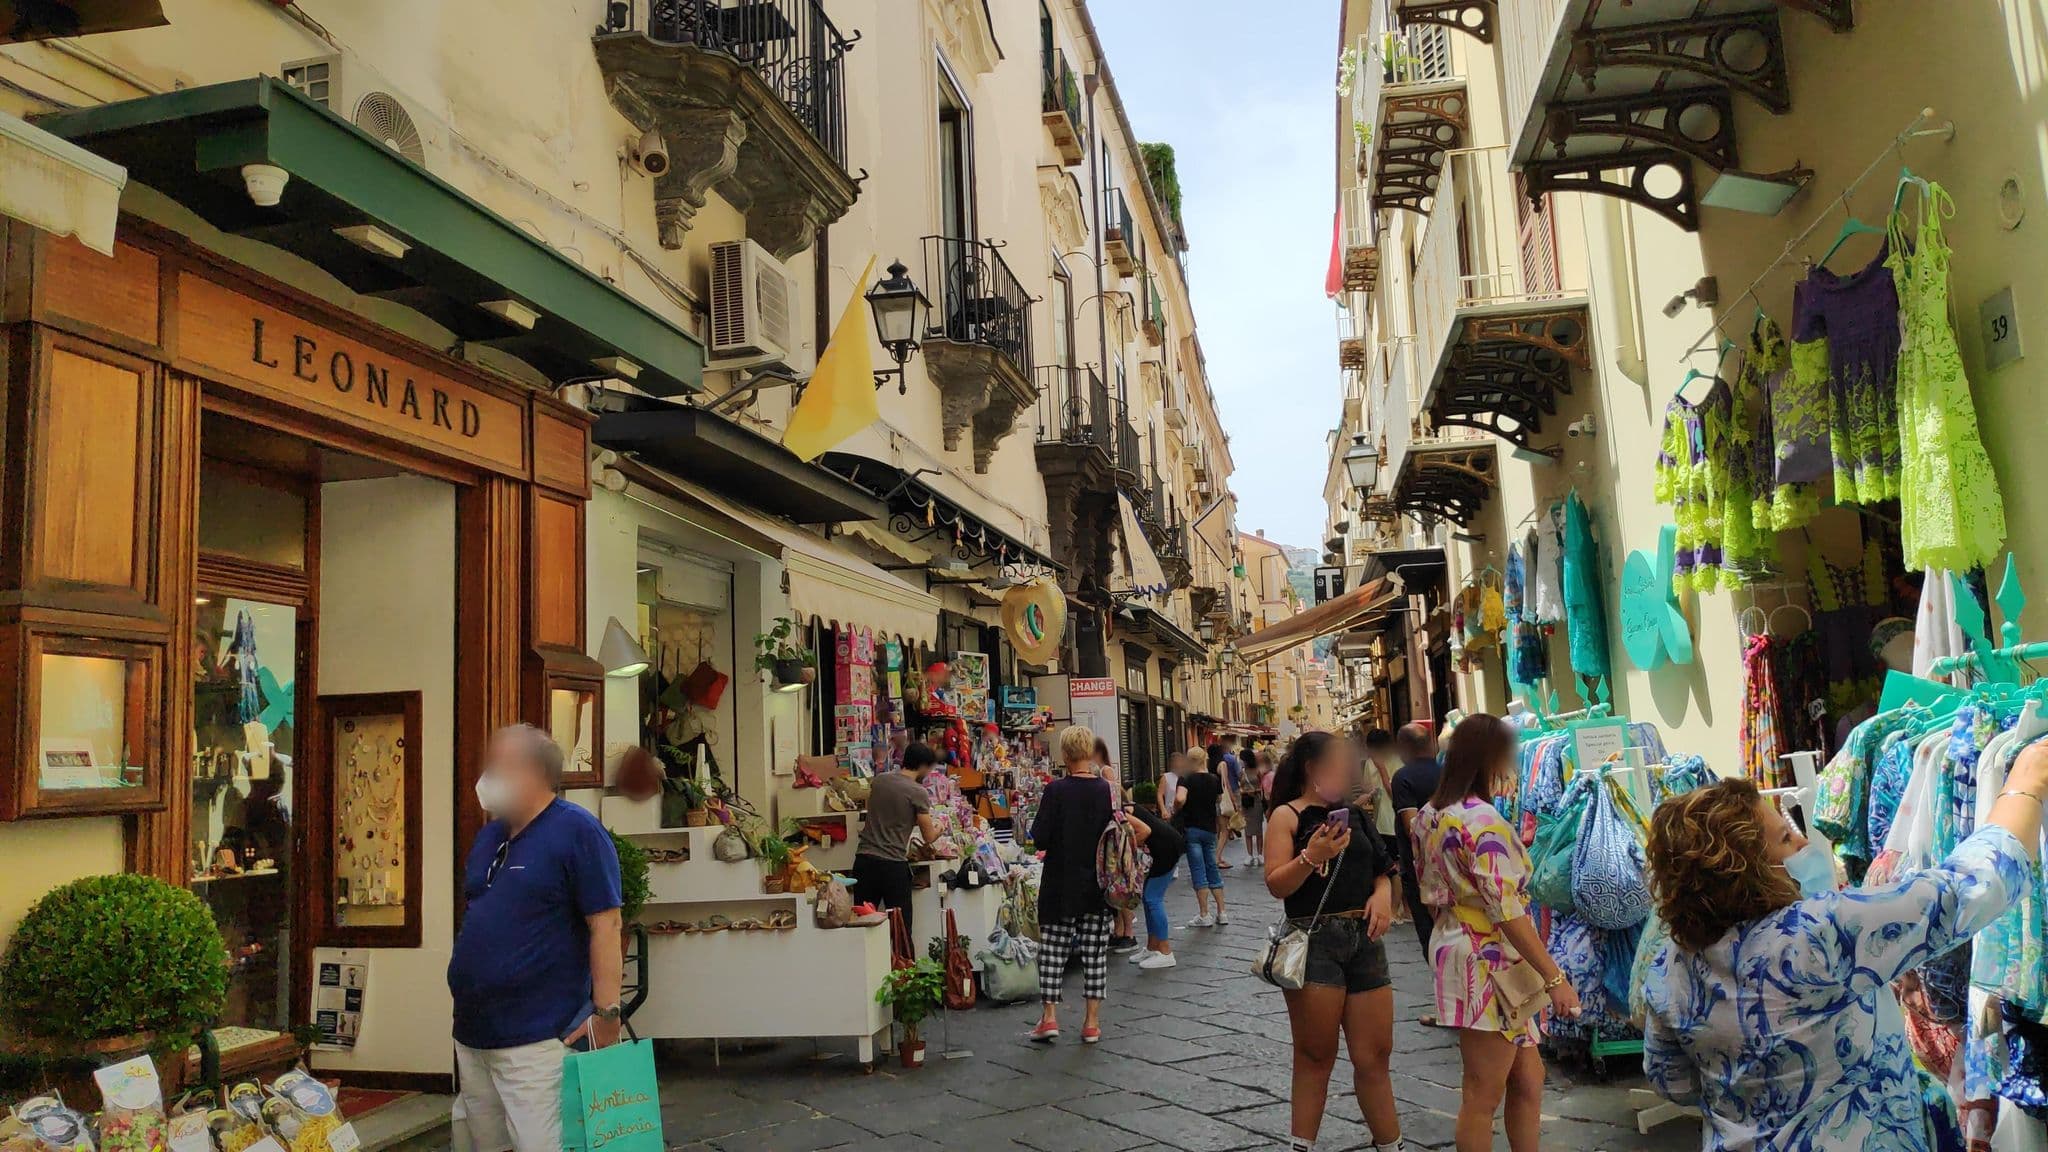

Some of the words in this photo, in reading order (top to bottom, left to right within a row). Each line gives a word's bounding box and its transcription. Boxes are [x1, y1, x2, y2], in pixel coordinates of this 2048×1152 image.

[1991, 315, 2008, 342] 39
[252, 318, 481, 438] LEONARD
[1316, 568, 1341, 599] T
[1070, 681, 1113, 692] CHANGE
[589, 1088, 652, 1118] Antica
